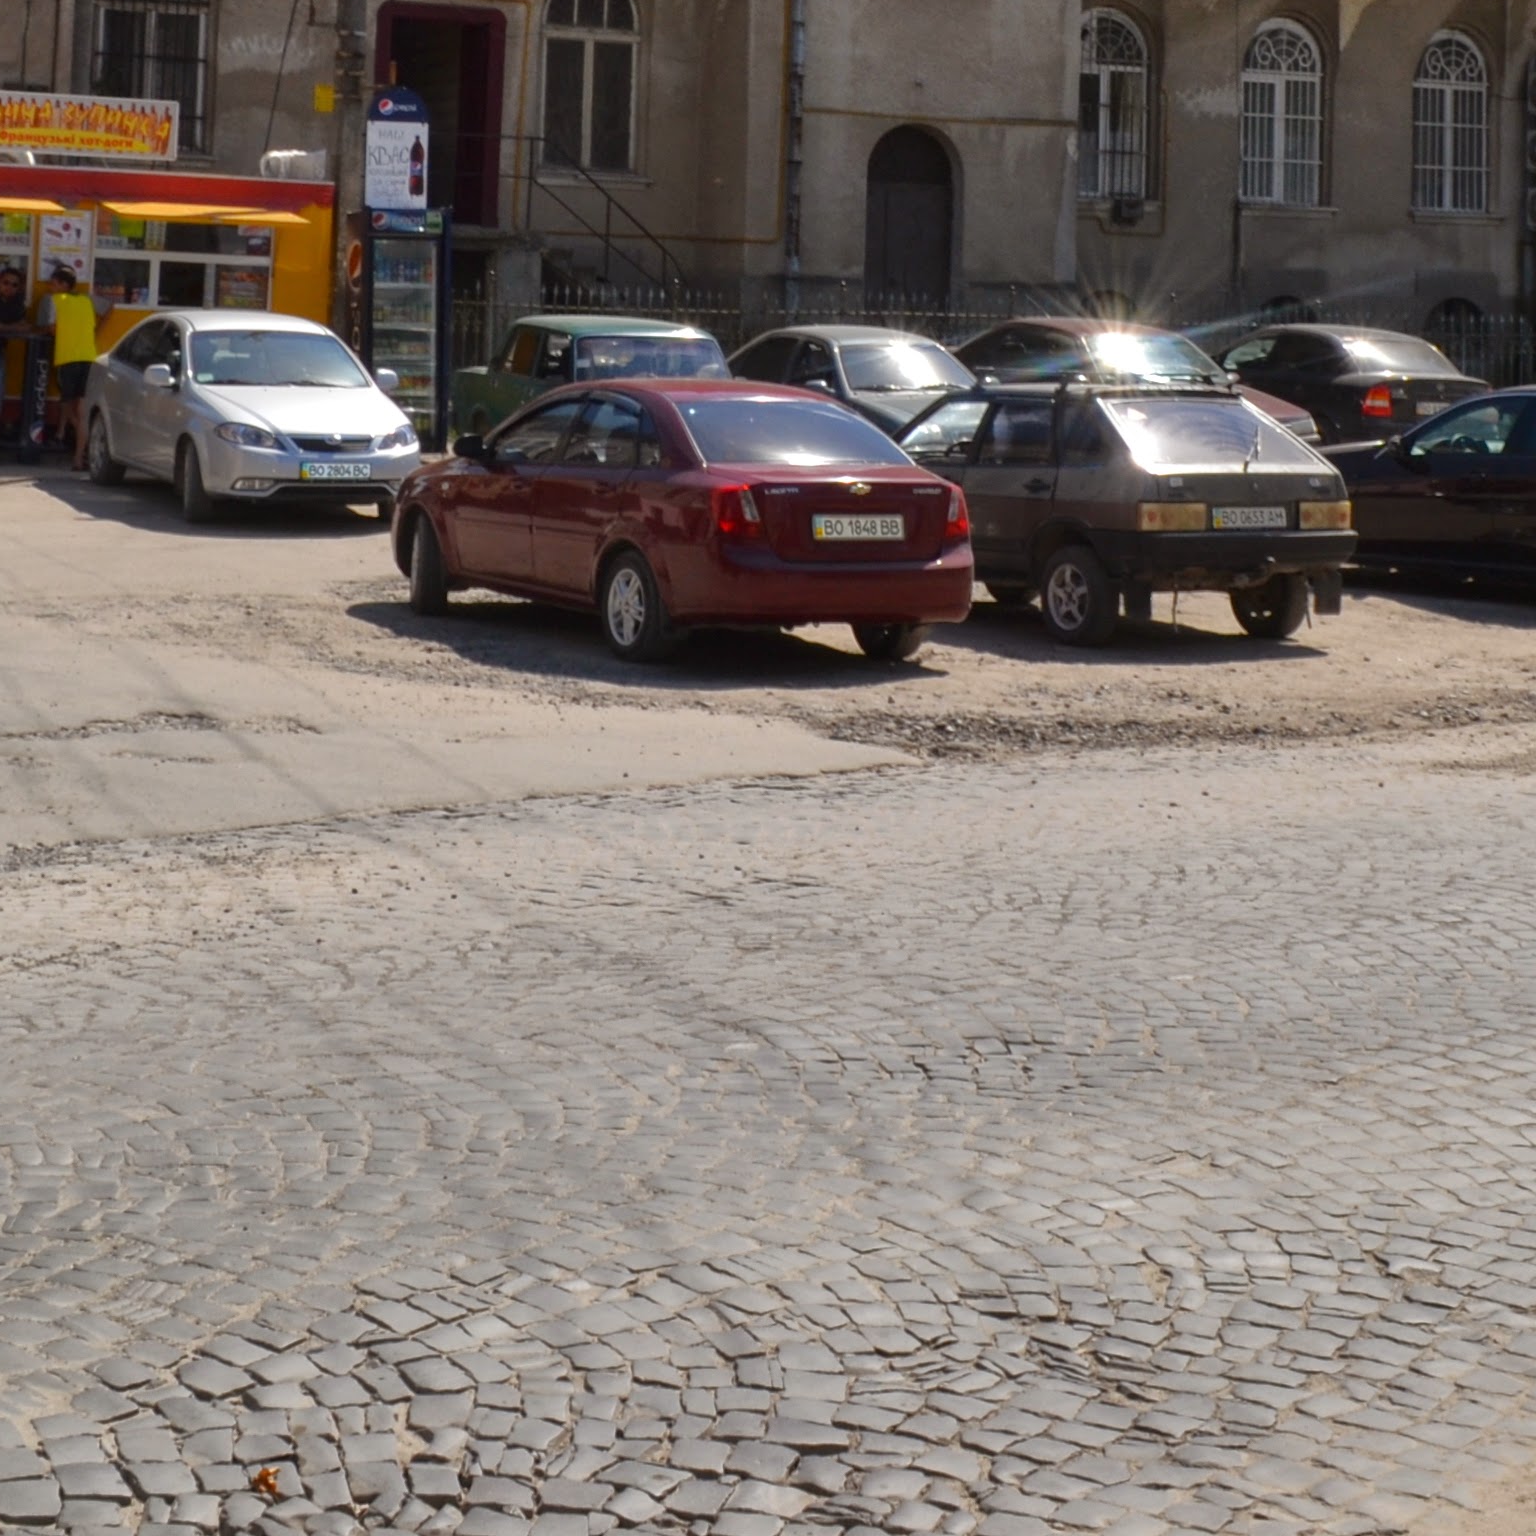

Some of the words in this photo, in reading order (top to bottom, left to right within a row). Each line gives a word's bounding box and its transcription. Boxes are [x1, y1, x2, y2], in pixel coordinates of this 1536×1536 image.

[79, 135, 134, 149] хот-доги
[368, 144, 410, 166] КВАС
[326, 465, 352, 476] 2804
[823, 520, 844, 535] BO
[848, 520, 878, 535] 1848
[880, 520, 900, 535] BB
